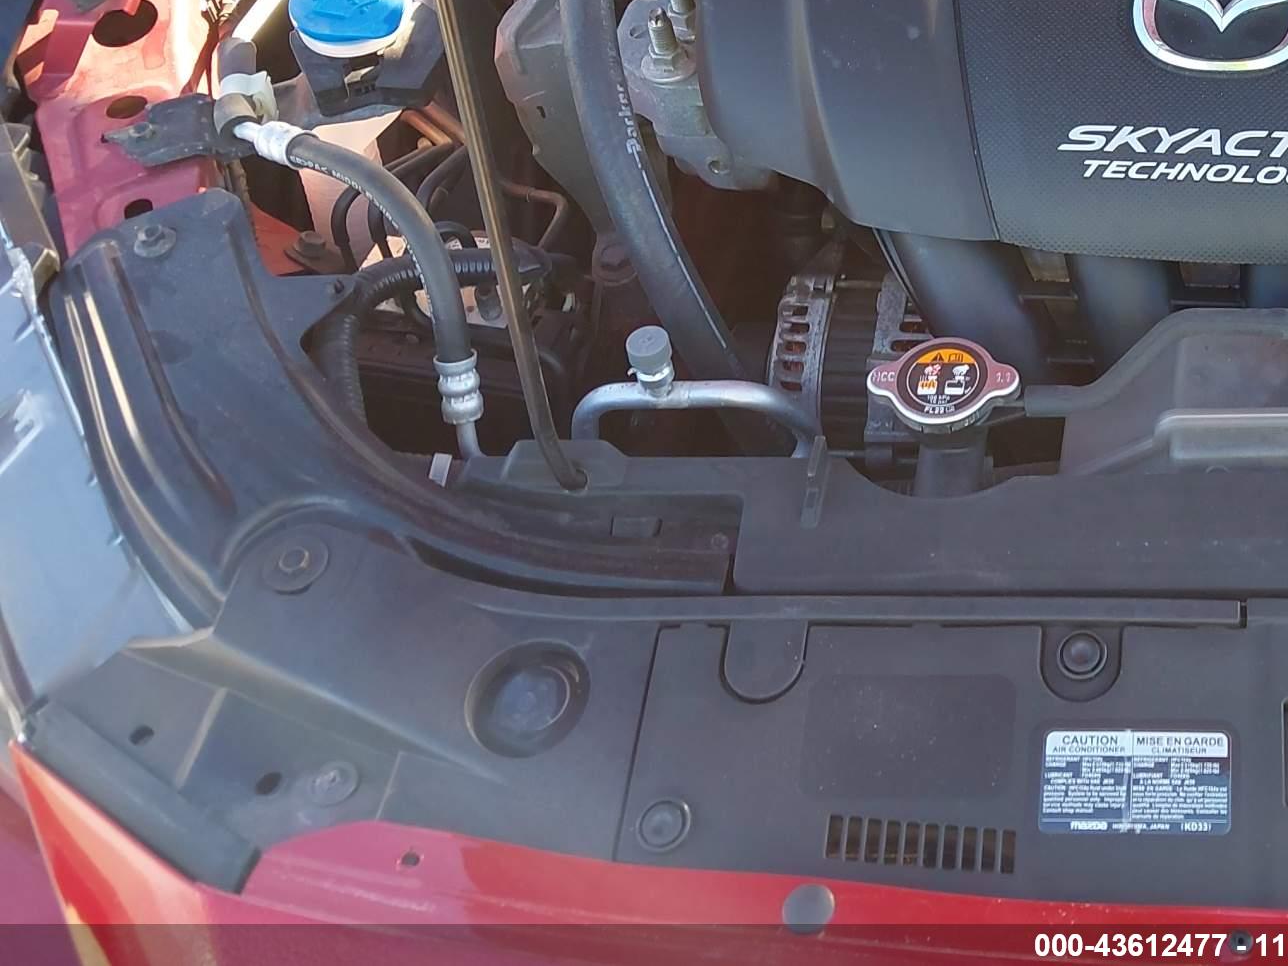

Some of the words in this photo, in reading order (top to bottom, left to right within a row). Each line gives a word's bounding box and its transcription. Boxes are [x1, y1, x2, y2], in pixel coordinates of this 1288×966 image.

[1062, 735, 1119, 745] CAUTION
[1136, 736, 1164, 746] MISE
[1166, 736, 1181, 746] EN
[1184, 736, 1224, 747] GARDE
